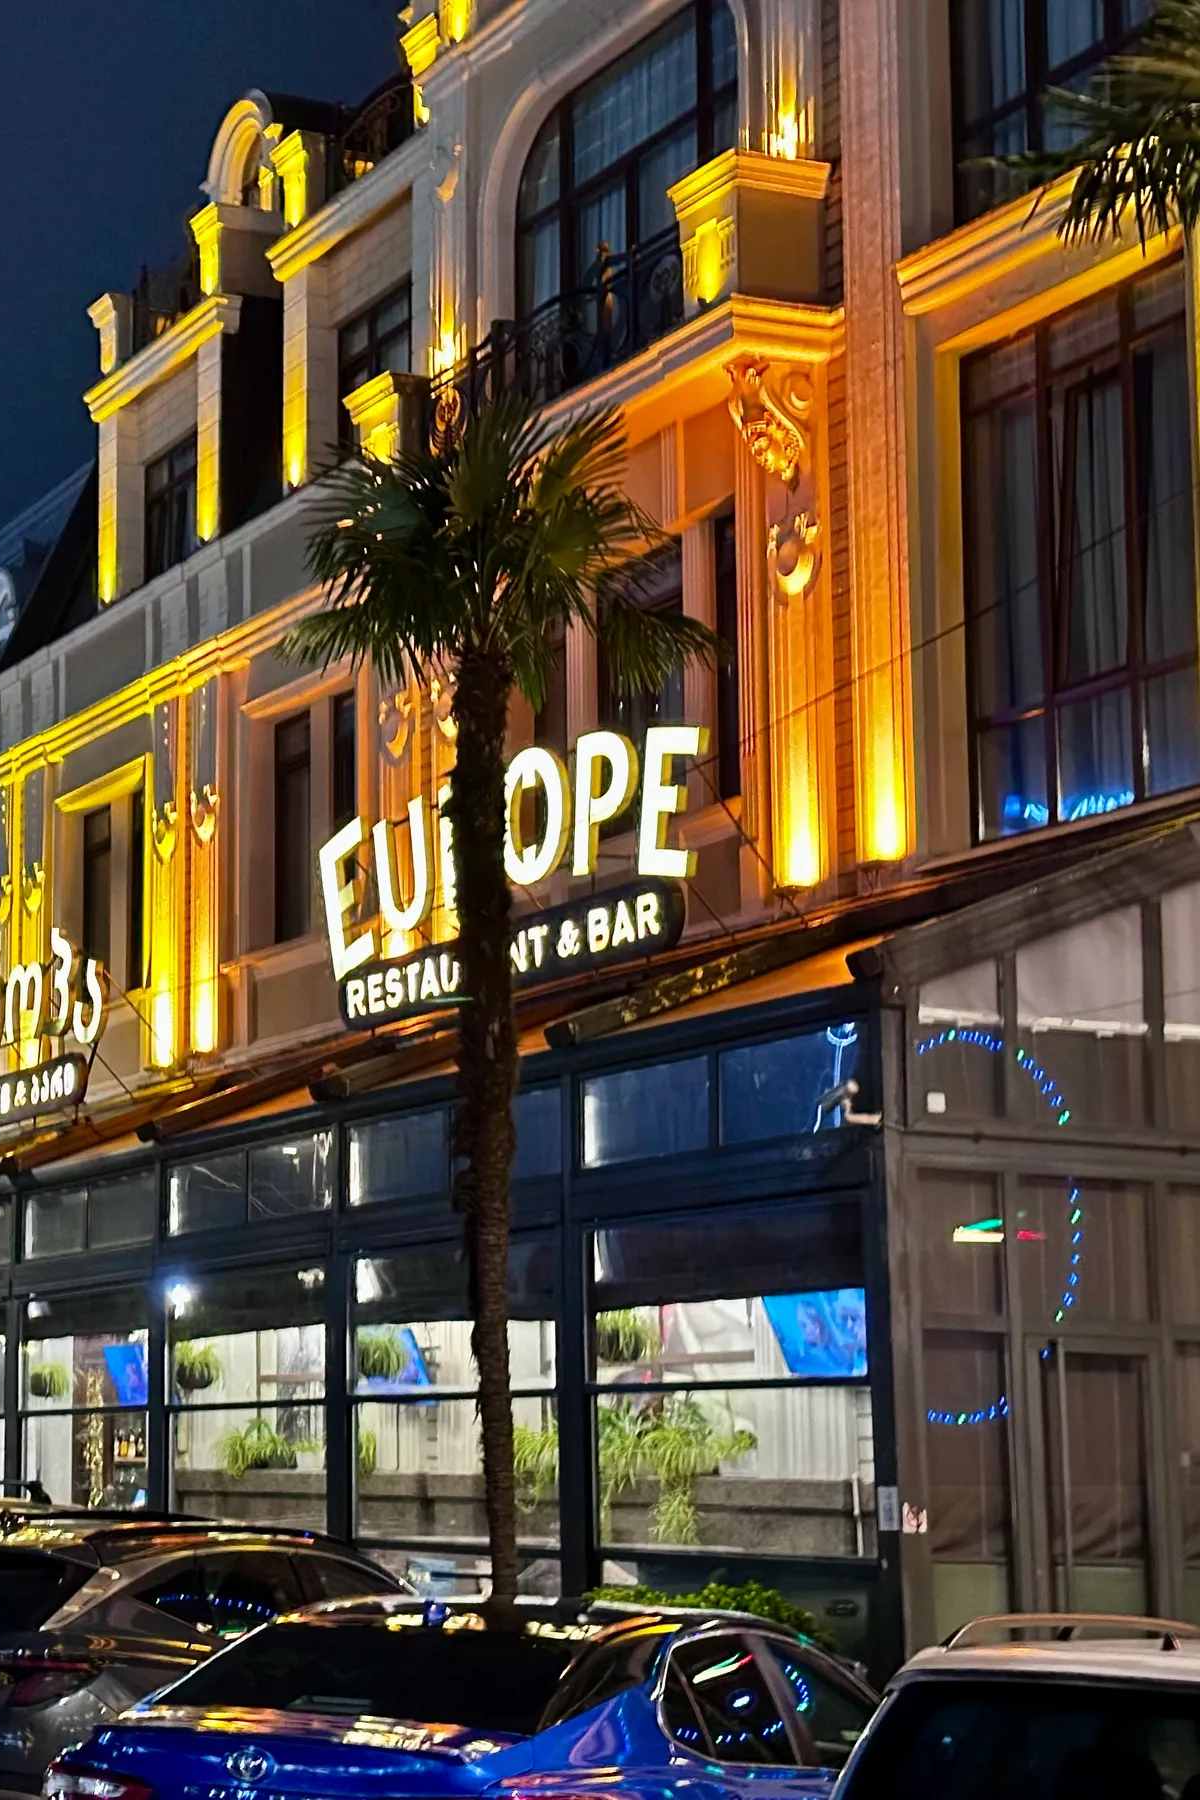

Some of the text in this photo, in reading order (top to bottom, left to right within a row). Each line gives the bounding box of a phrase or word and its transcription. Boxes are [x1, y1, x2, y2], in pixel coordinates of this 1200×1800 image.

[346, 892, 661, 1019] RESTAUNT & BAR
[14, 1080, 27, 1107] &
[30, 1062, 75, 1105] ბარი
